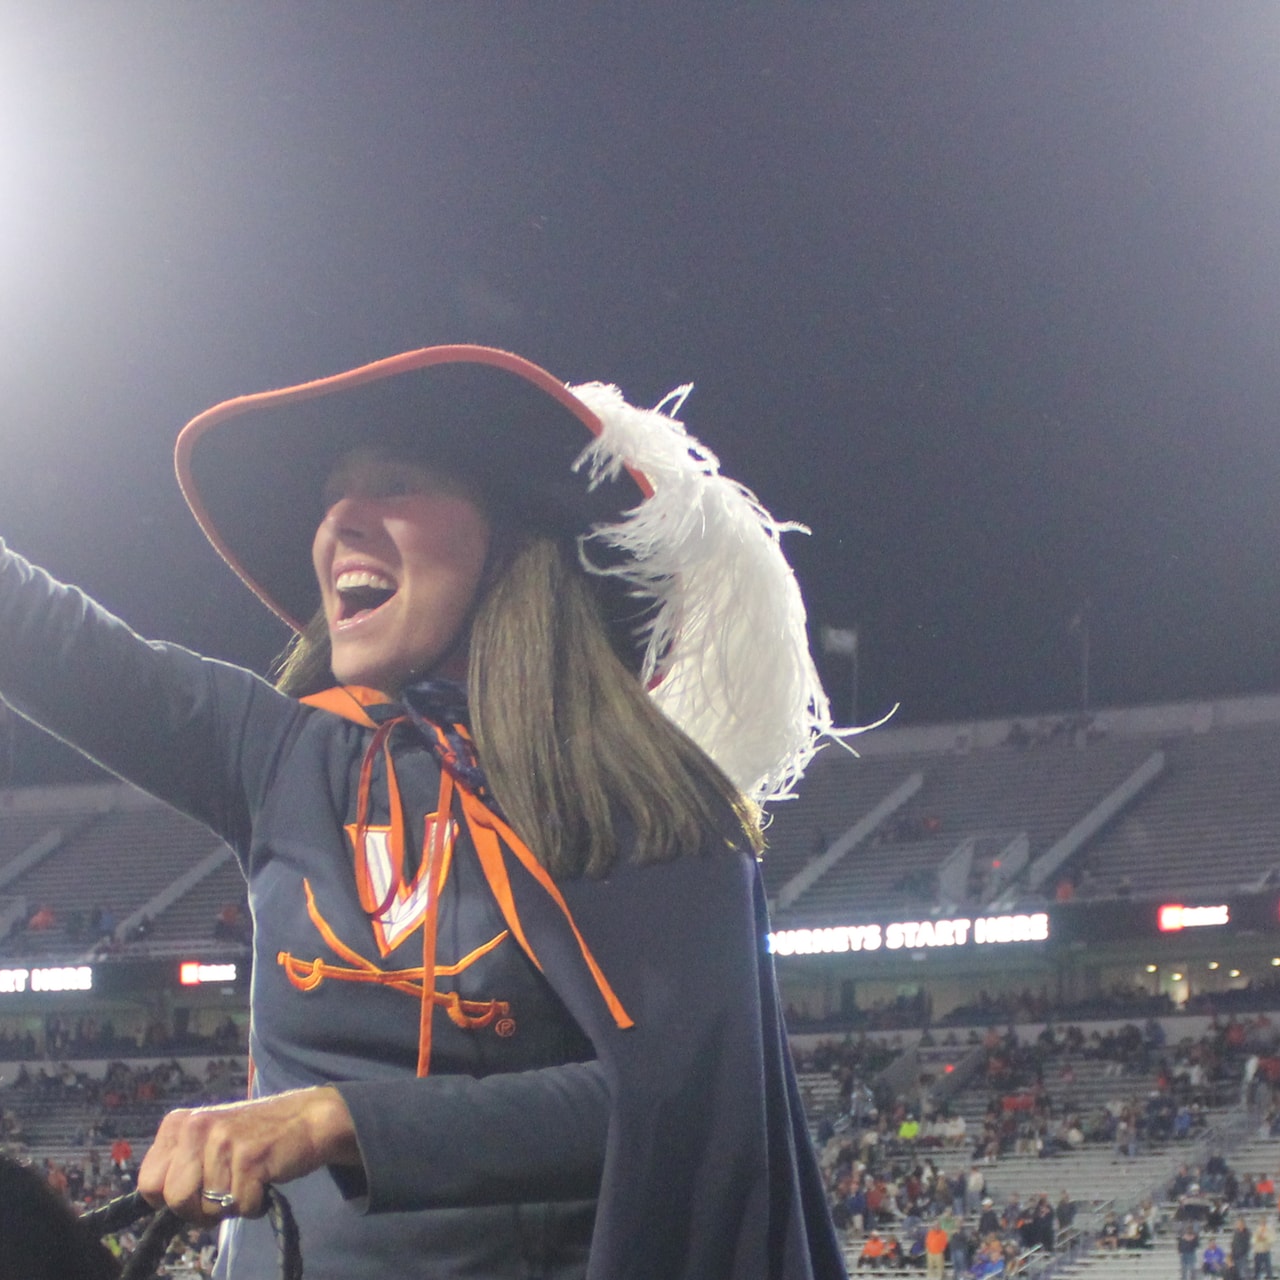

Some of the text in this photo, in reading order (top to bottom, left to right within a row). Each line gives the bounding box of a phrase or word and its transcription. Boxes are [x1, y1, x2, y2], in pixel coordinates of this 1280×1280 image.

[885, 918, 972, 950] START
[974, 913, 1049, 944] HERE
[30, 966, 93, 992] HERE
